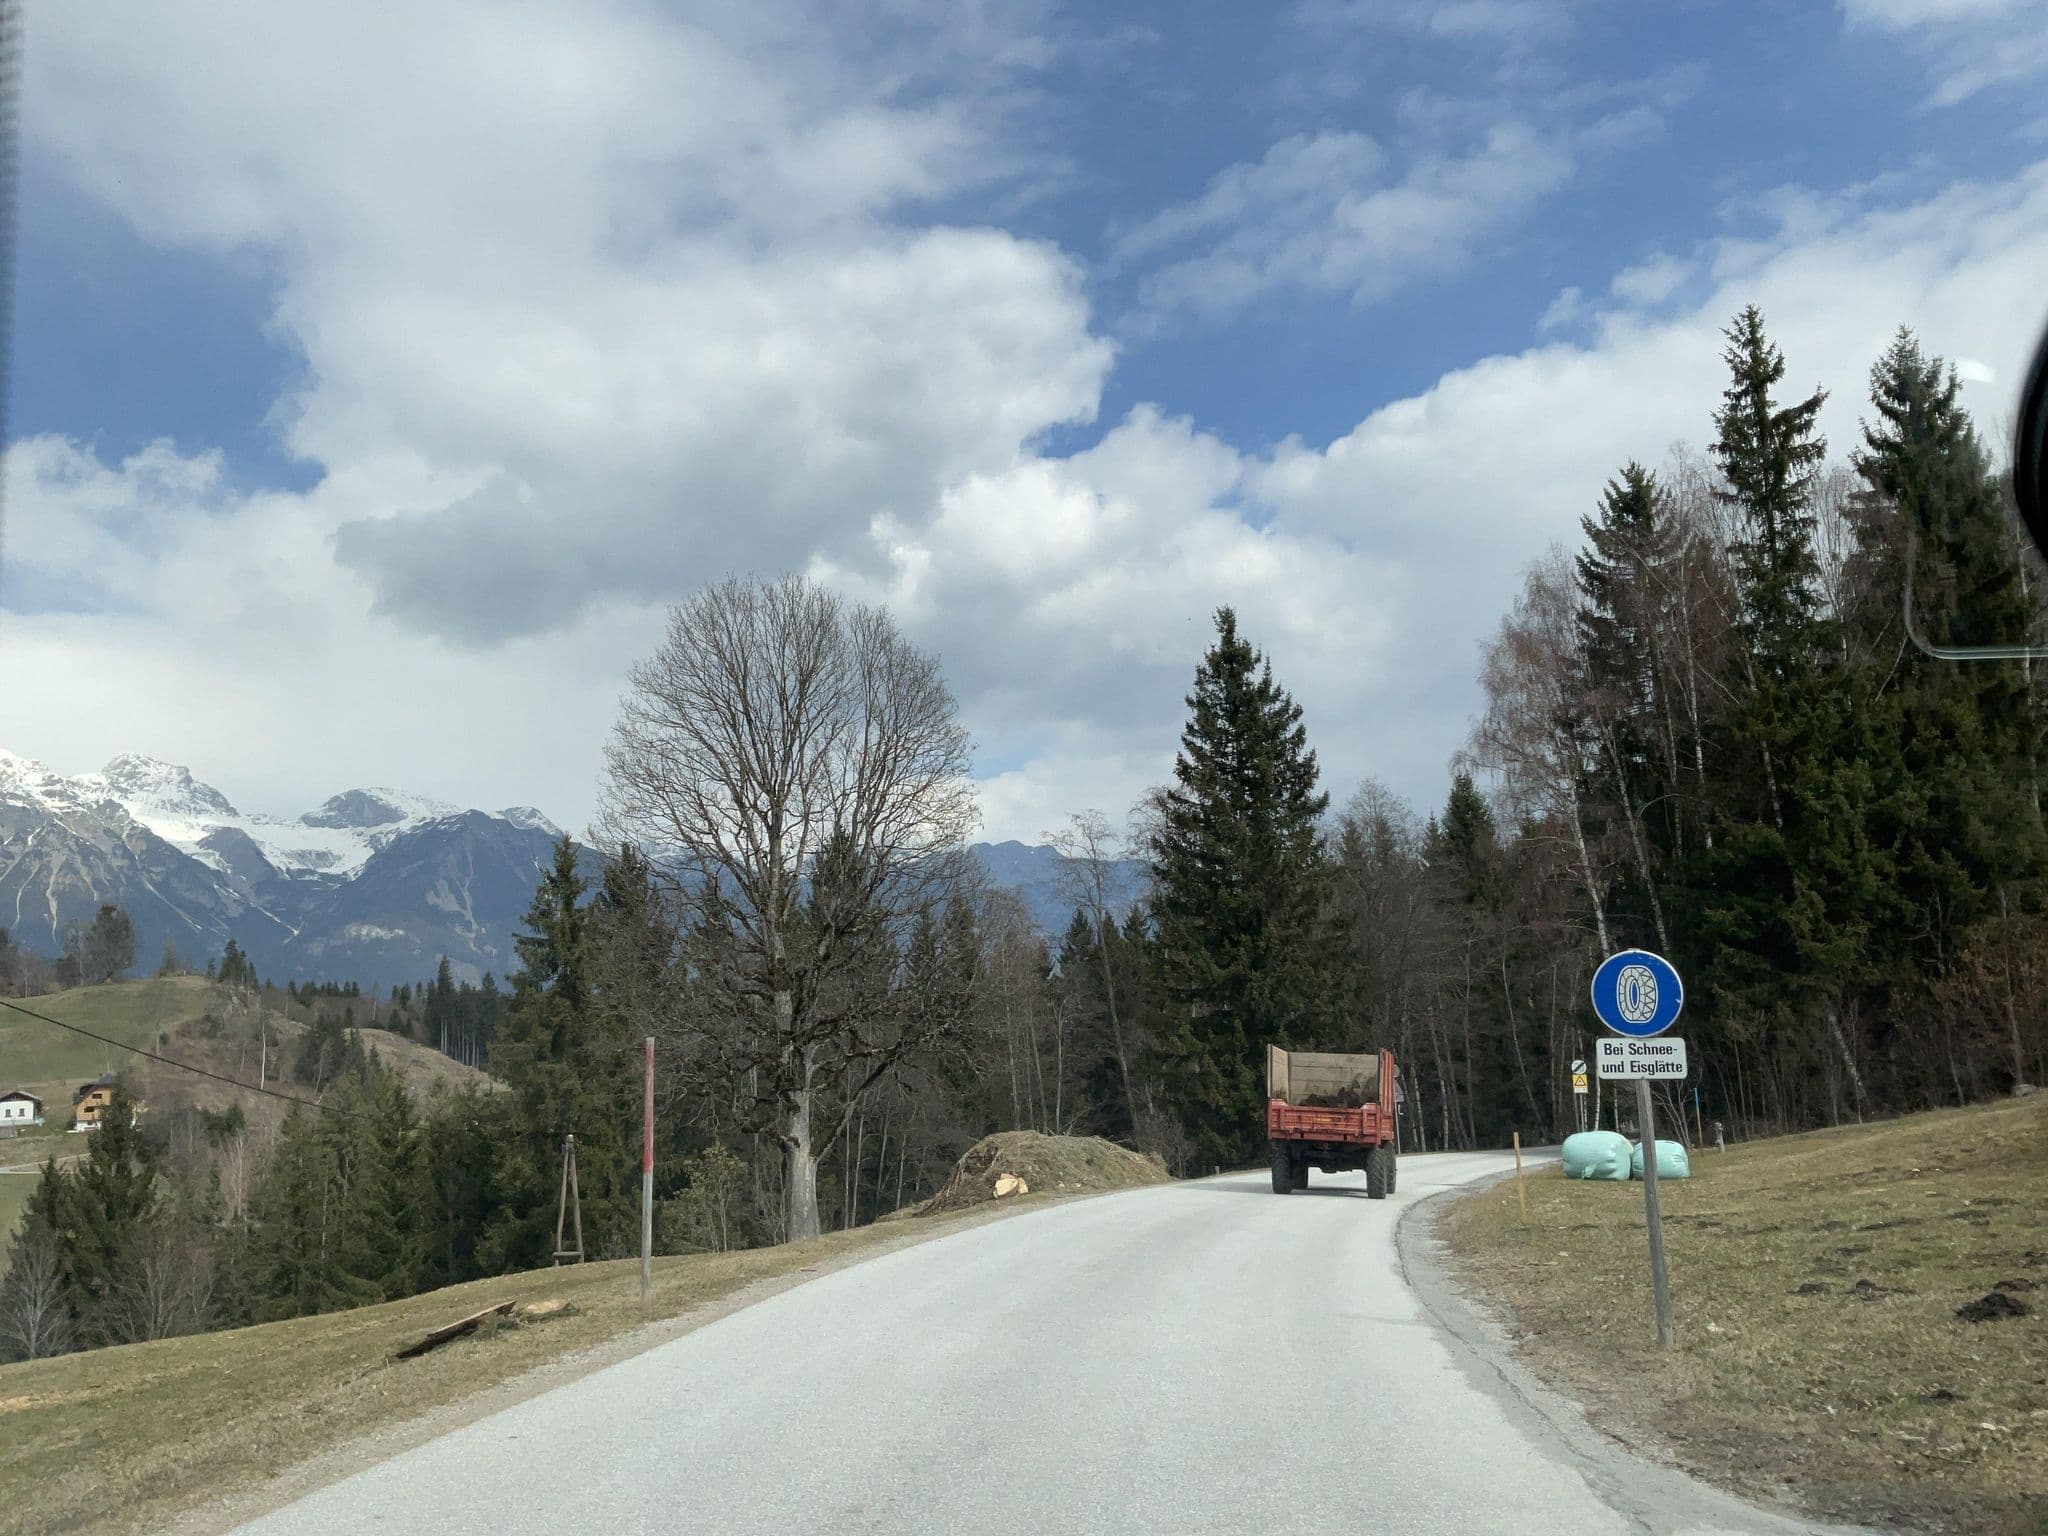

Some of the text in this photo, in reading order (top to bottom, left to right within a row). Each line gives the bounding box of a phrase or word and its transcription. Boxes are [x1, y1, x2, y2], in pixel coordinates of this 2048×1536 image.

[1604, 1043, 1678, 1055] Bei Schnee-
[1602, 1061, 1624, 1073] und
[1630, 1060, 1683, 1075] Eisglätte
